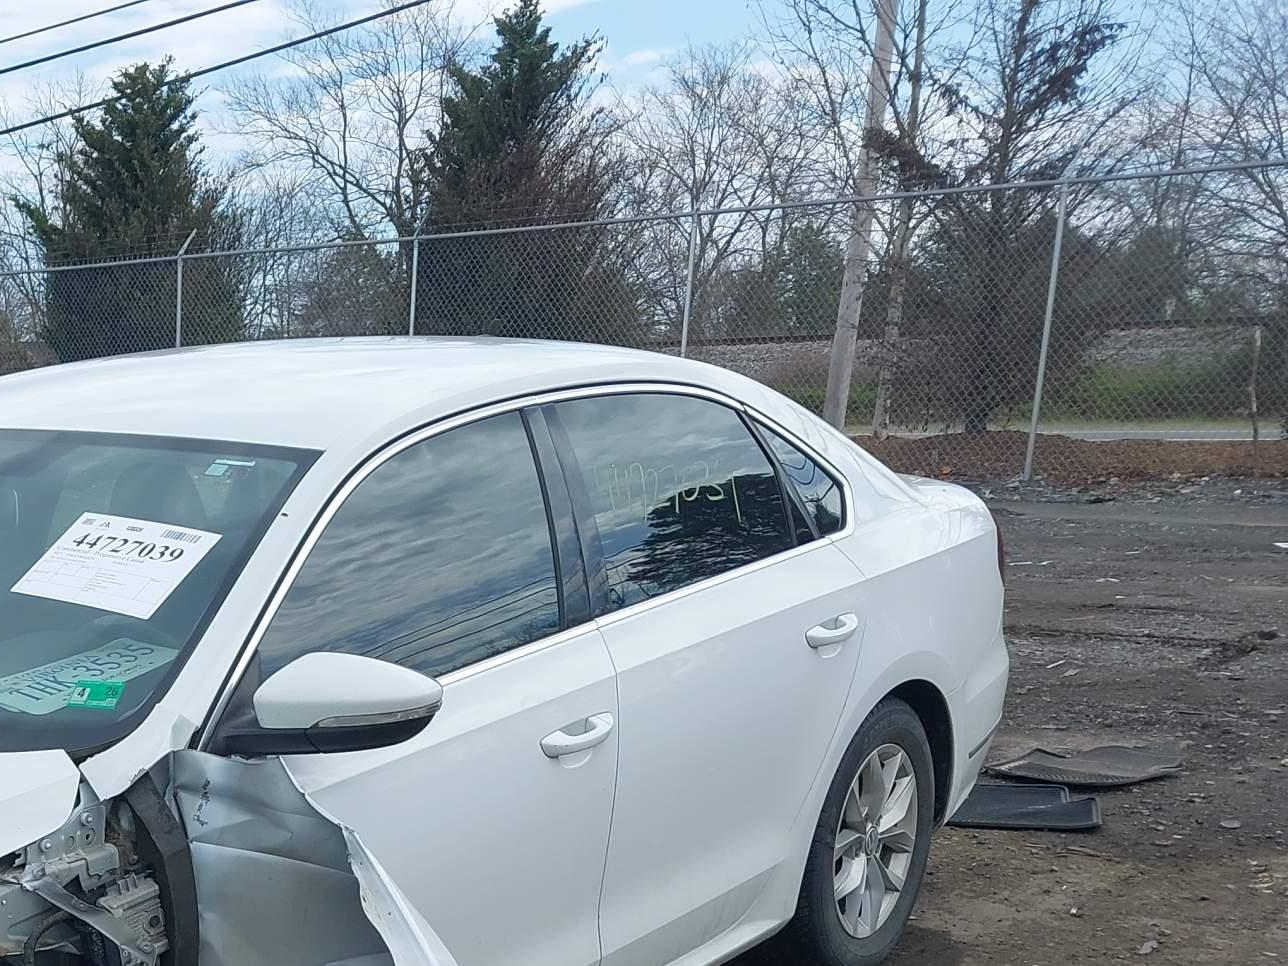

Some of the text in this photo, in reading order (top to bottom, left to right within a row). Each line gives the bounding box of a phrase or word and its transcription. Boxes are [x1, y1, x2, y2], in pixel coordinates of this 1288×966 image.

[72, 532, 185, 563] 44727039
[23, 655, 99, 682] VIRGINIA
[77, 686, 117, 698] 4 26
